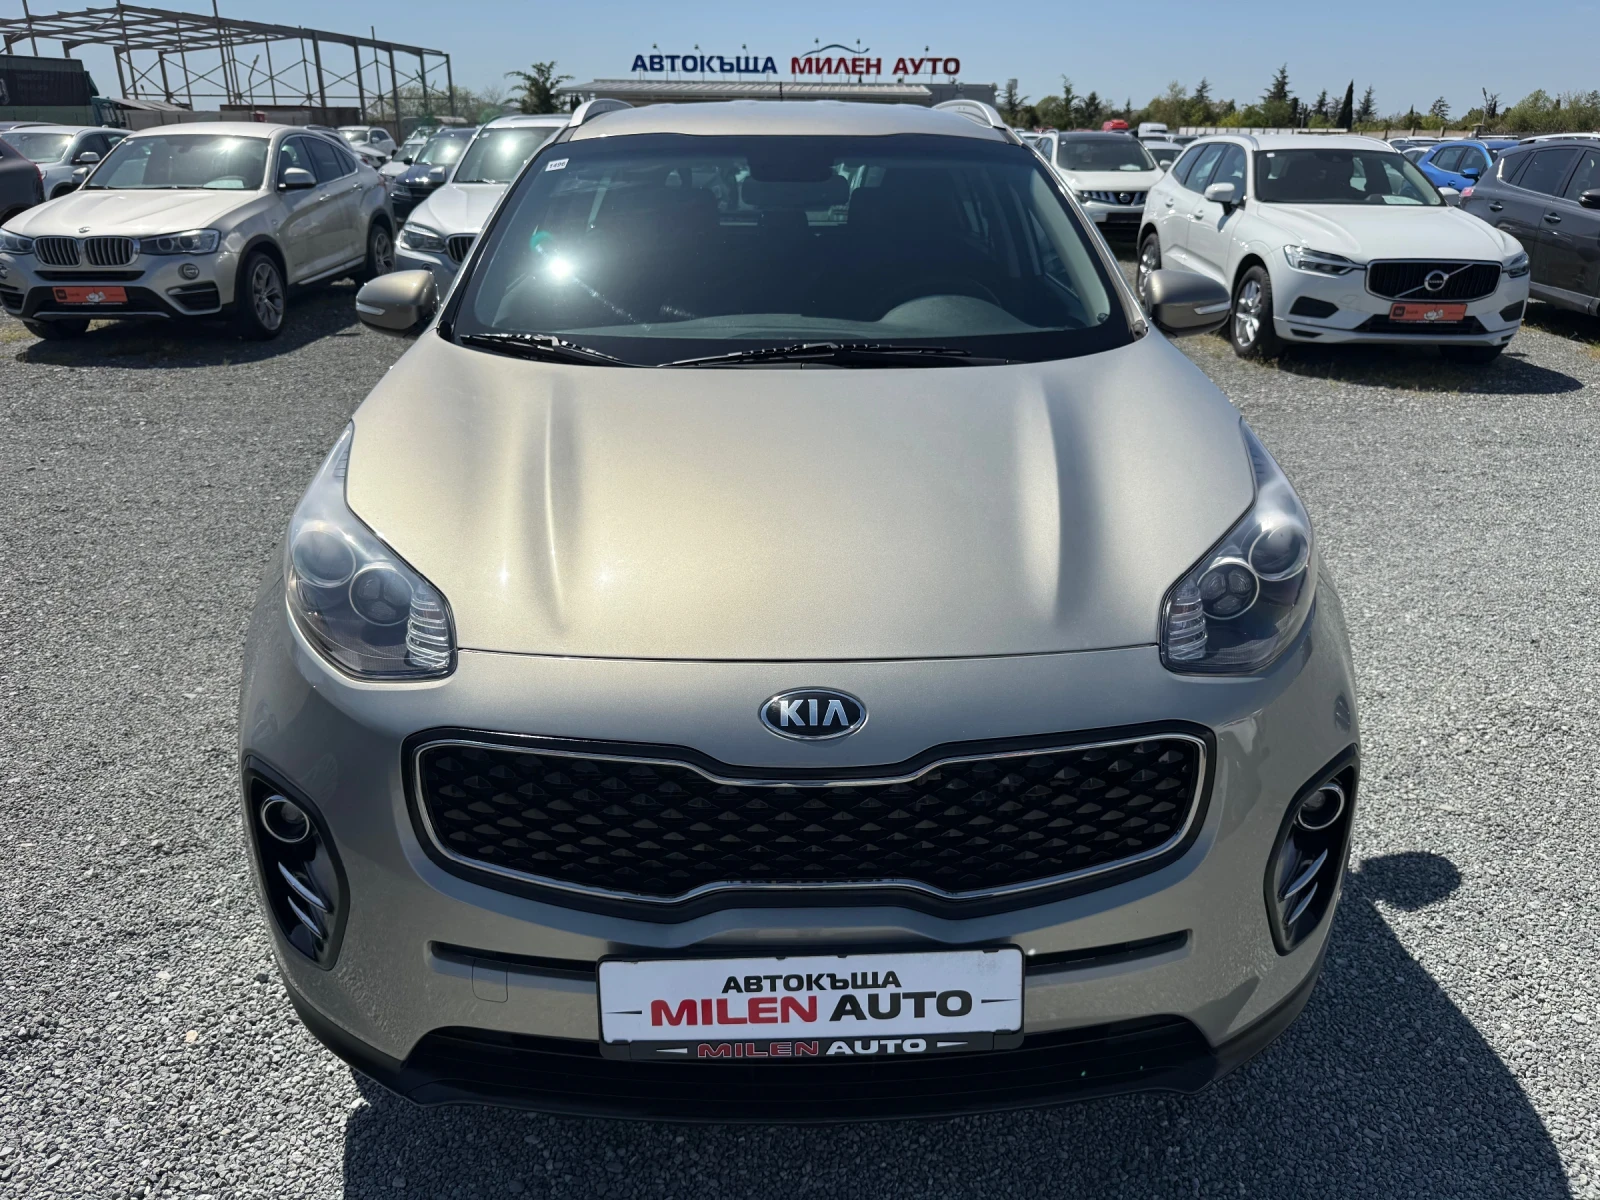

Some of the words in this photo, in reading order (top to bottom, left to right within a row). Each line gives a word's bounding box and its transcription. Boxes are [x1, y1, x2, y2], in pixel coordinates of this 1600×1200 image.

[791, 57, 882, 75] МИЛЕН
[892, 57, 961, 75] АУТО
[779, 698, 849, 727] KIA
[650, 995, 817, 1027] MILEN
[829, 989, 973, 1022] AUTO
[697, 1040, 819, 1058] MILEN
[825, 1037, 927, 1056] AUTO
